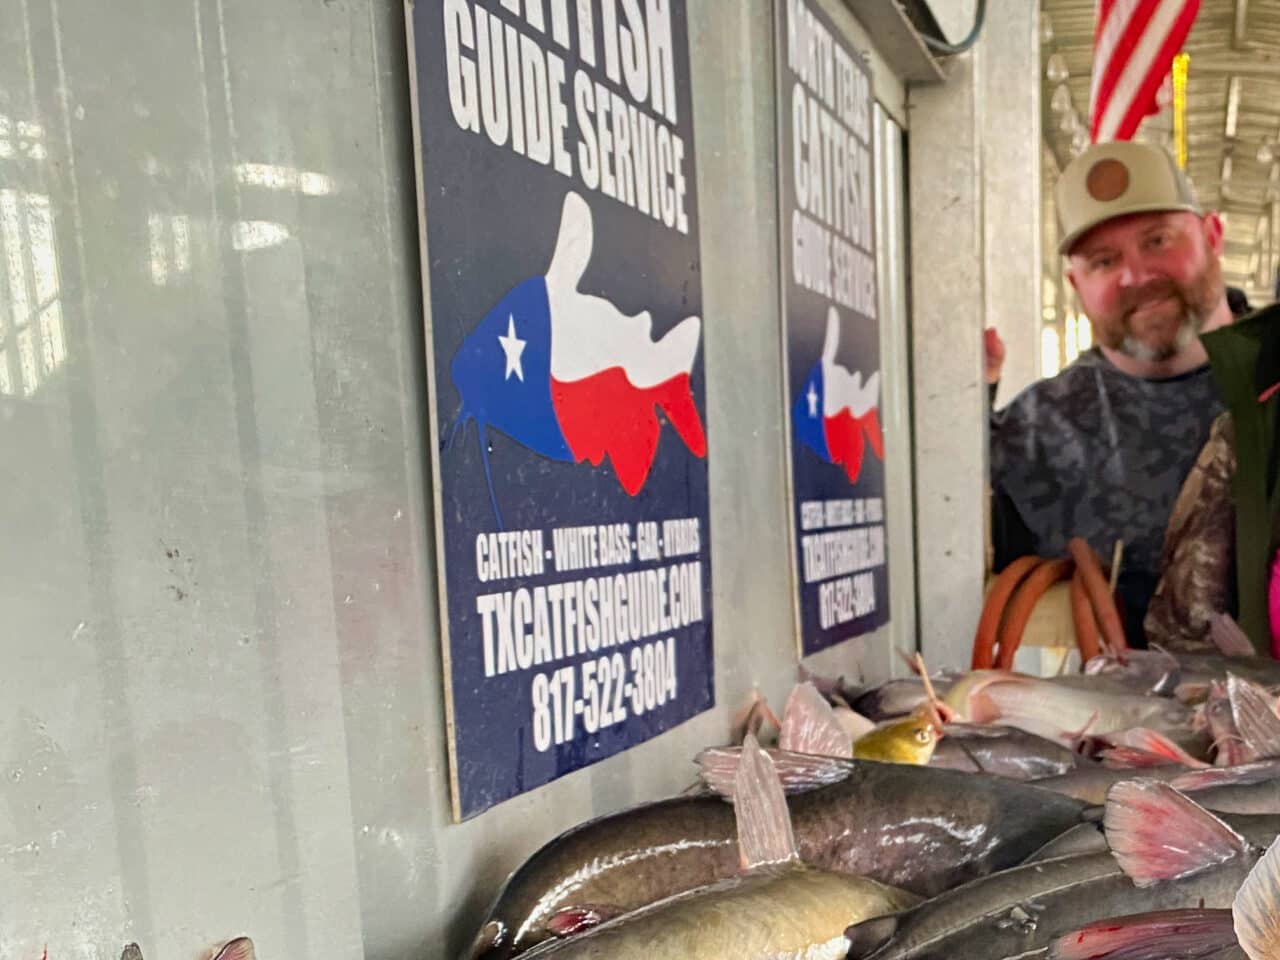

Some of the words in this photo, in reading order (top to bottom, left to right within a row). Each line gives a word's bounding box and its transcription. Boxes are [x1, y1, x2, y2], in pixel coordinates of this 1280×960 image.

[443, 0, 572, 177] GUIDE
[574, 69, 688, 234] SERVICE
[476, 529, 544, 582] CATFISH
[552, 526, 598, 571] WHITE
[599, 522, 631, 566] BASS
[476, 561, 703, 677] TXCATFISHGUIDE.COM
[532, 637, 677, 752] 817-522-3804
